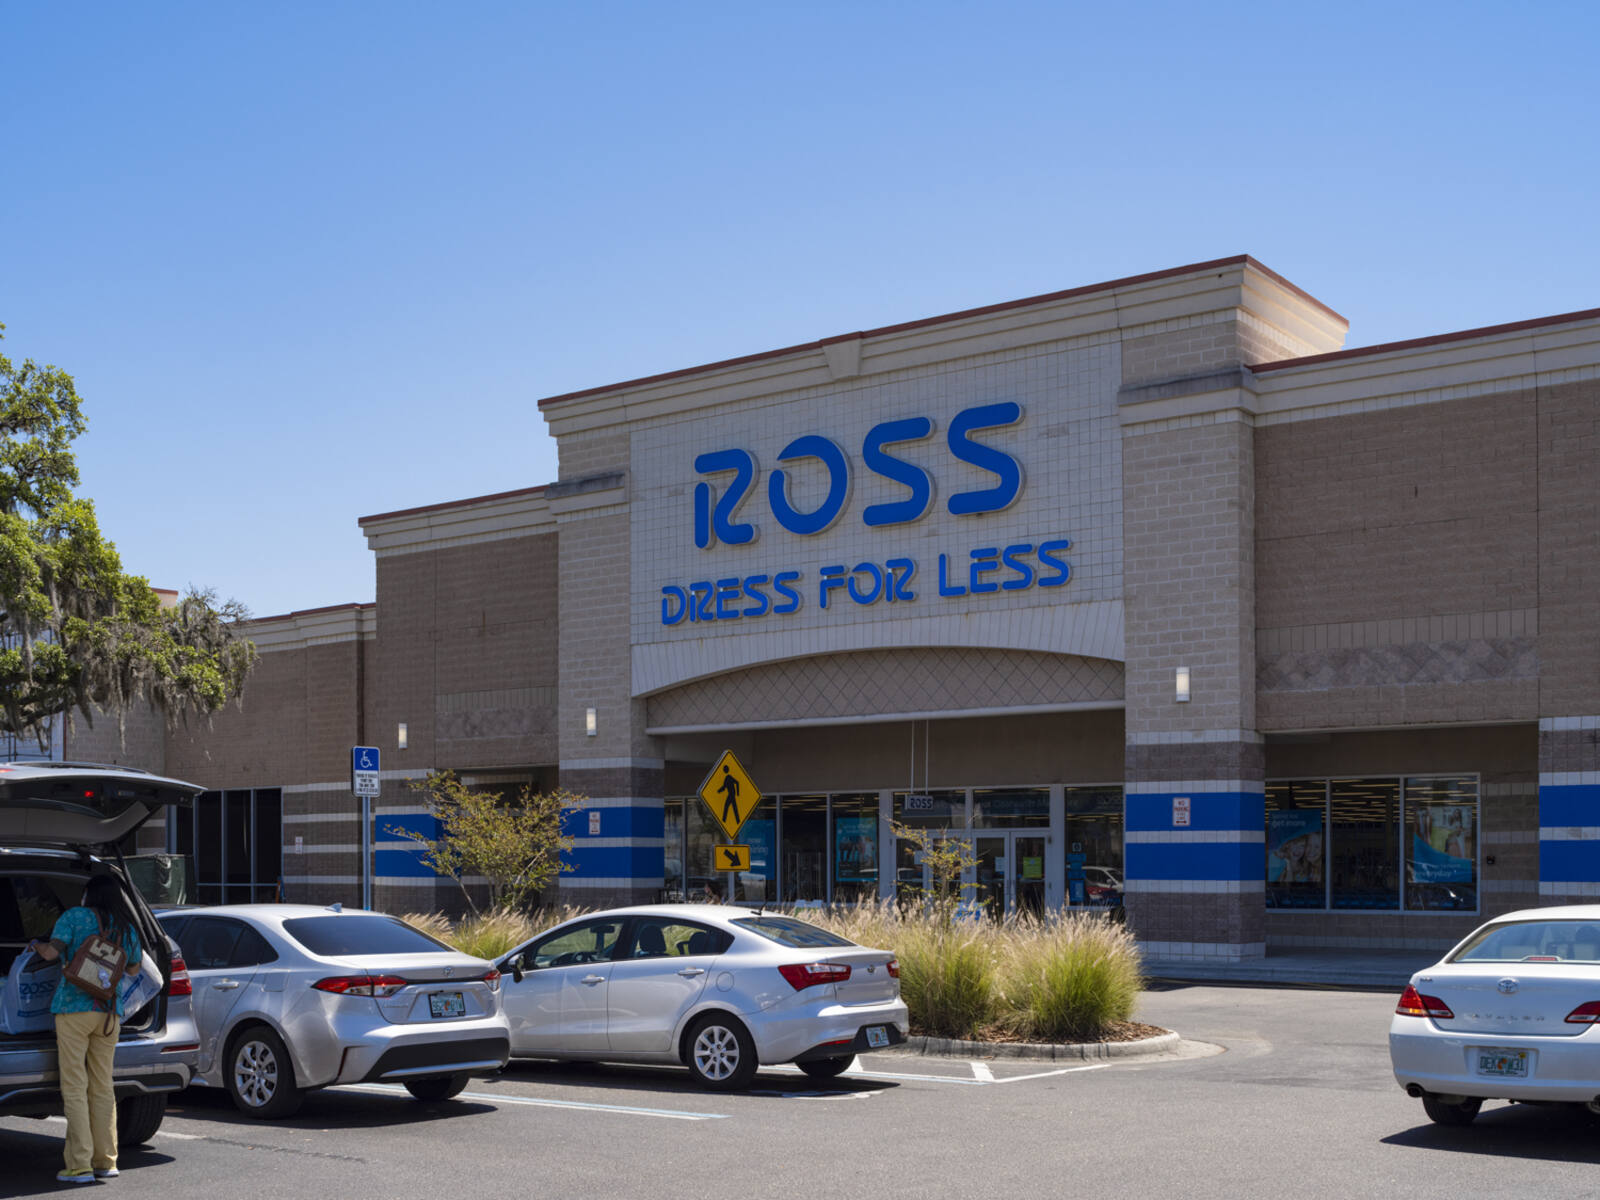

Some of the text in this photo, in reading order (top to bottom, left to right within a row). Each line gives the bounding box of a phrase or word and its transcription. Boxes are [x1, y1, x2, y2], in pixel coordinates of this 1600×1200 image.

[694, 402, 1022, 550] ROSS
[661, 539, 1072, 626] DRESS FOR LESS
[909, 797, 932, 809] ROSS
[19, 979, 56, 995] ROSS
